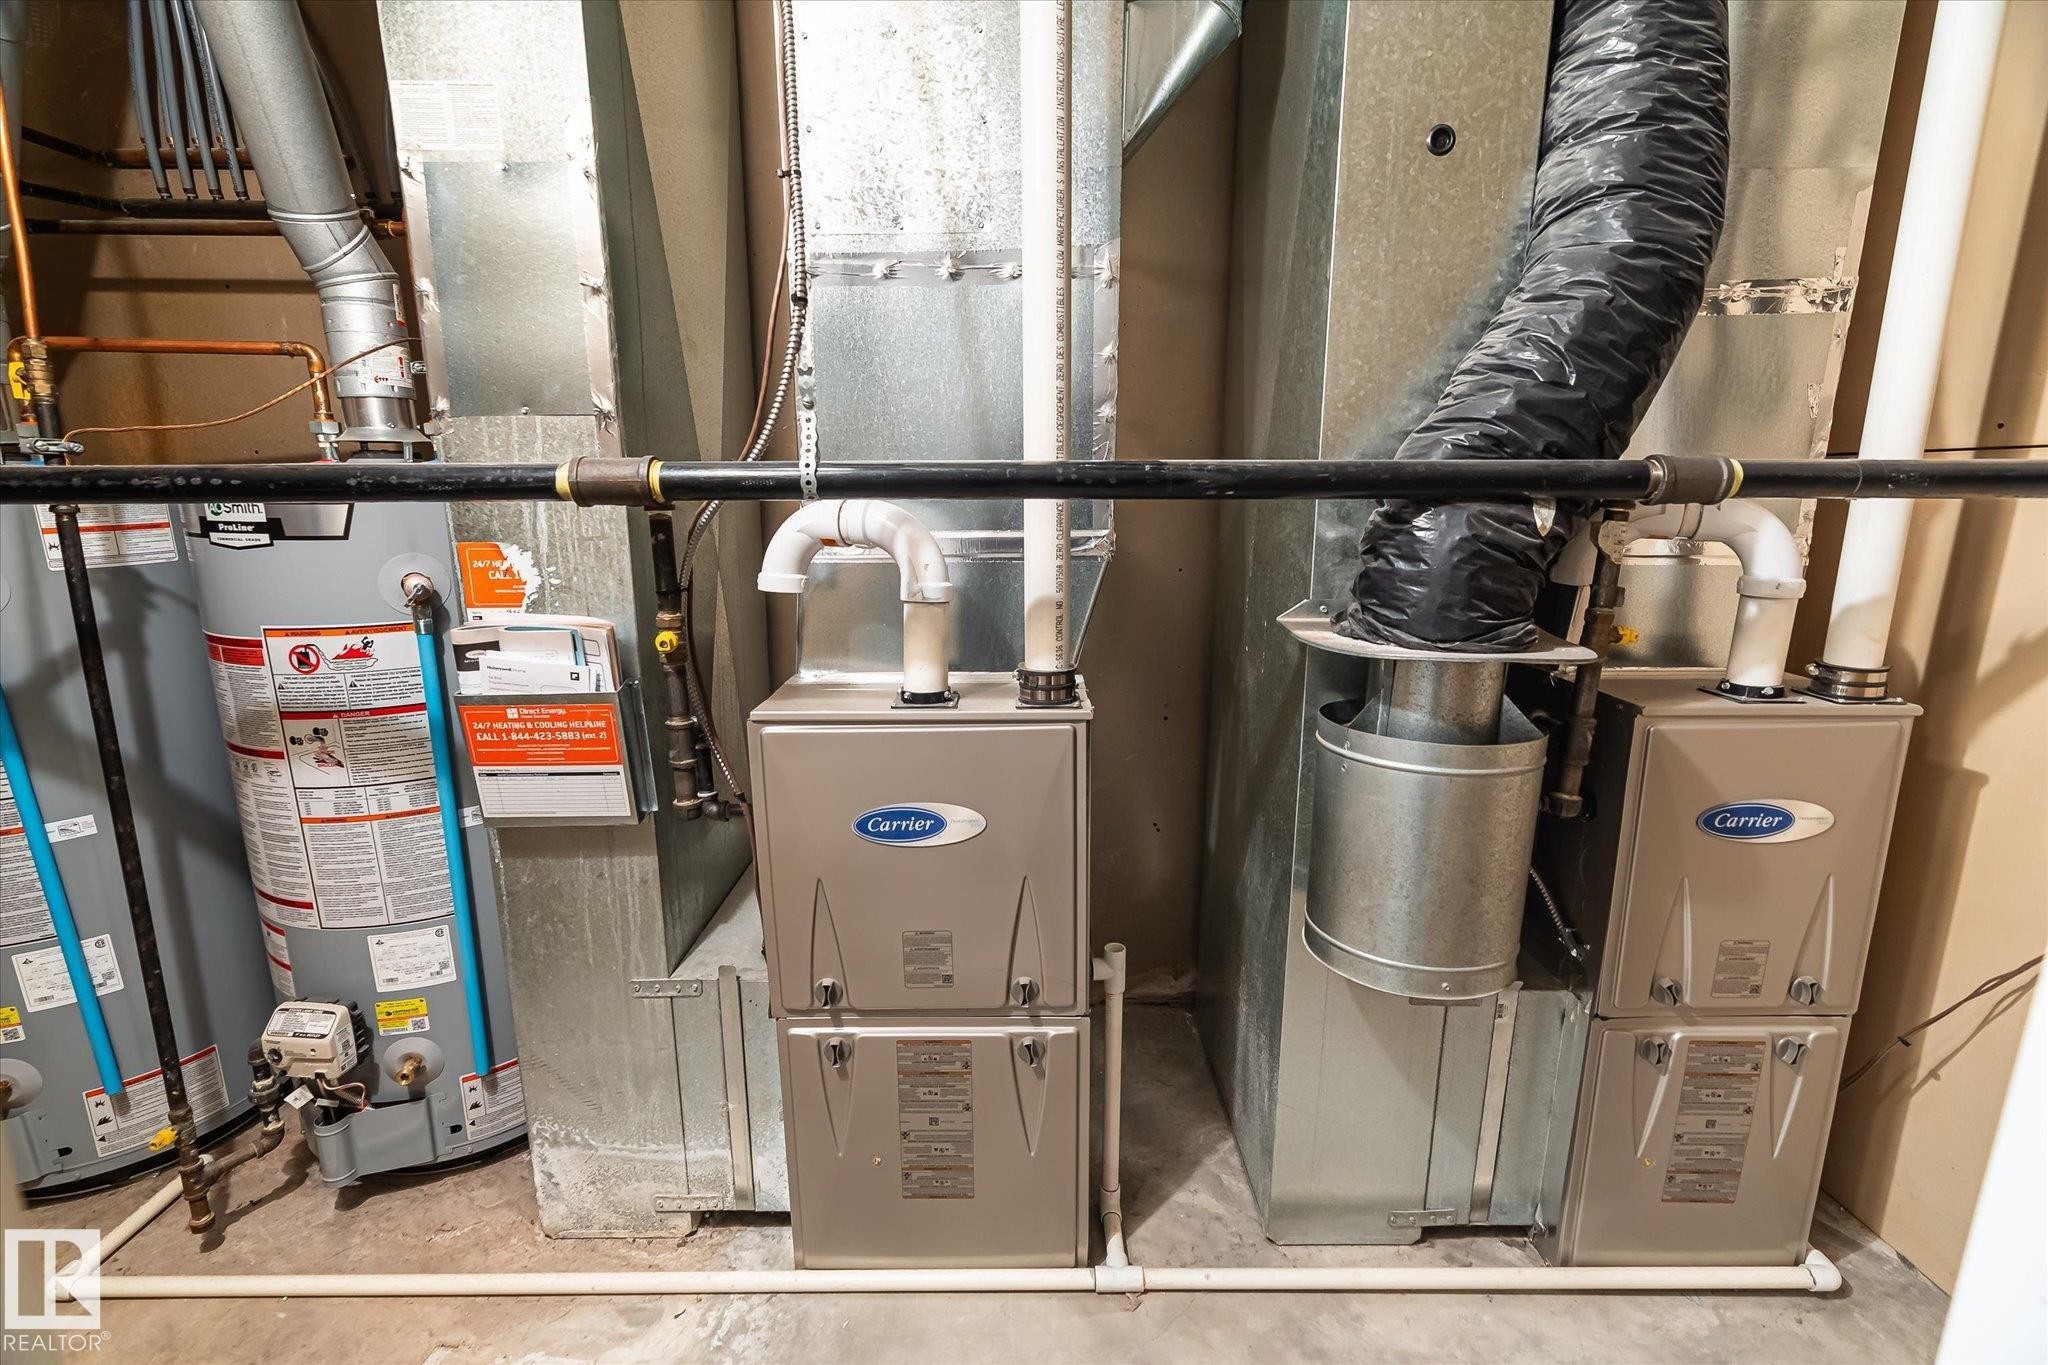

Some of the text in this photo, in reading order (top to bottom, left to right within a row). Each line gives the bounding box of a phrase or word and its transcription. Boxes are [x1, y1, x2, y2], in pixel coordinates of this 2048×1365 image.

[1056, 116, 1064, 174] INSTALLATION
[1056, 249, 1064, 279] FOLLOW
[1056, 287, 1064, 341] COMBUSTIBLES
[1056, 346, 1064, 359] DES
[1056, 363, 1064, 382] ZERO
[1056, 386, 1064, 459] TIBLES/DEGAGEMENT
[218, 523, 252, 532] ProLine
[1056, 502, 1064, 540] CLEARANCE
[1056, 544, 1064, 560] ZERO
[541, 707, 566, 716] Energy
[473, 720, 607, 730] 24/7 HEATING & COOLING HELPLINE
[476, 732, 499, 741] CALL
[867, 816, 934, 832] Carrier
[1714, 812, 1783, 828] Carrier
